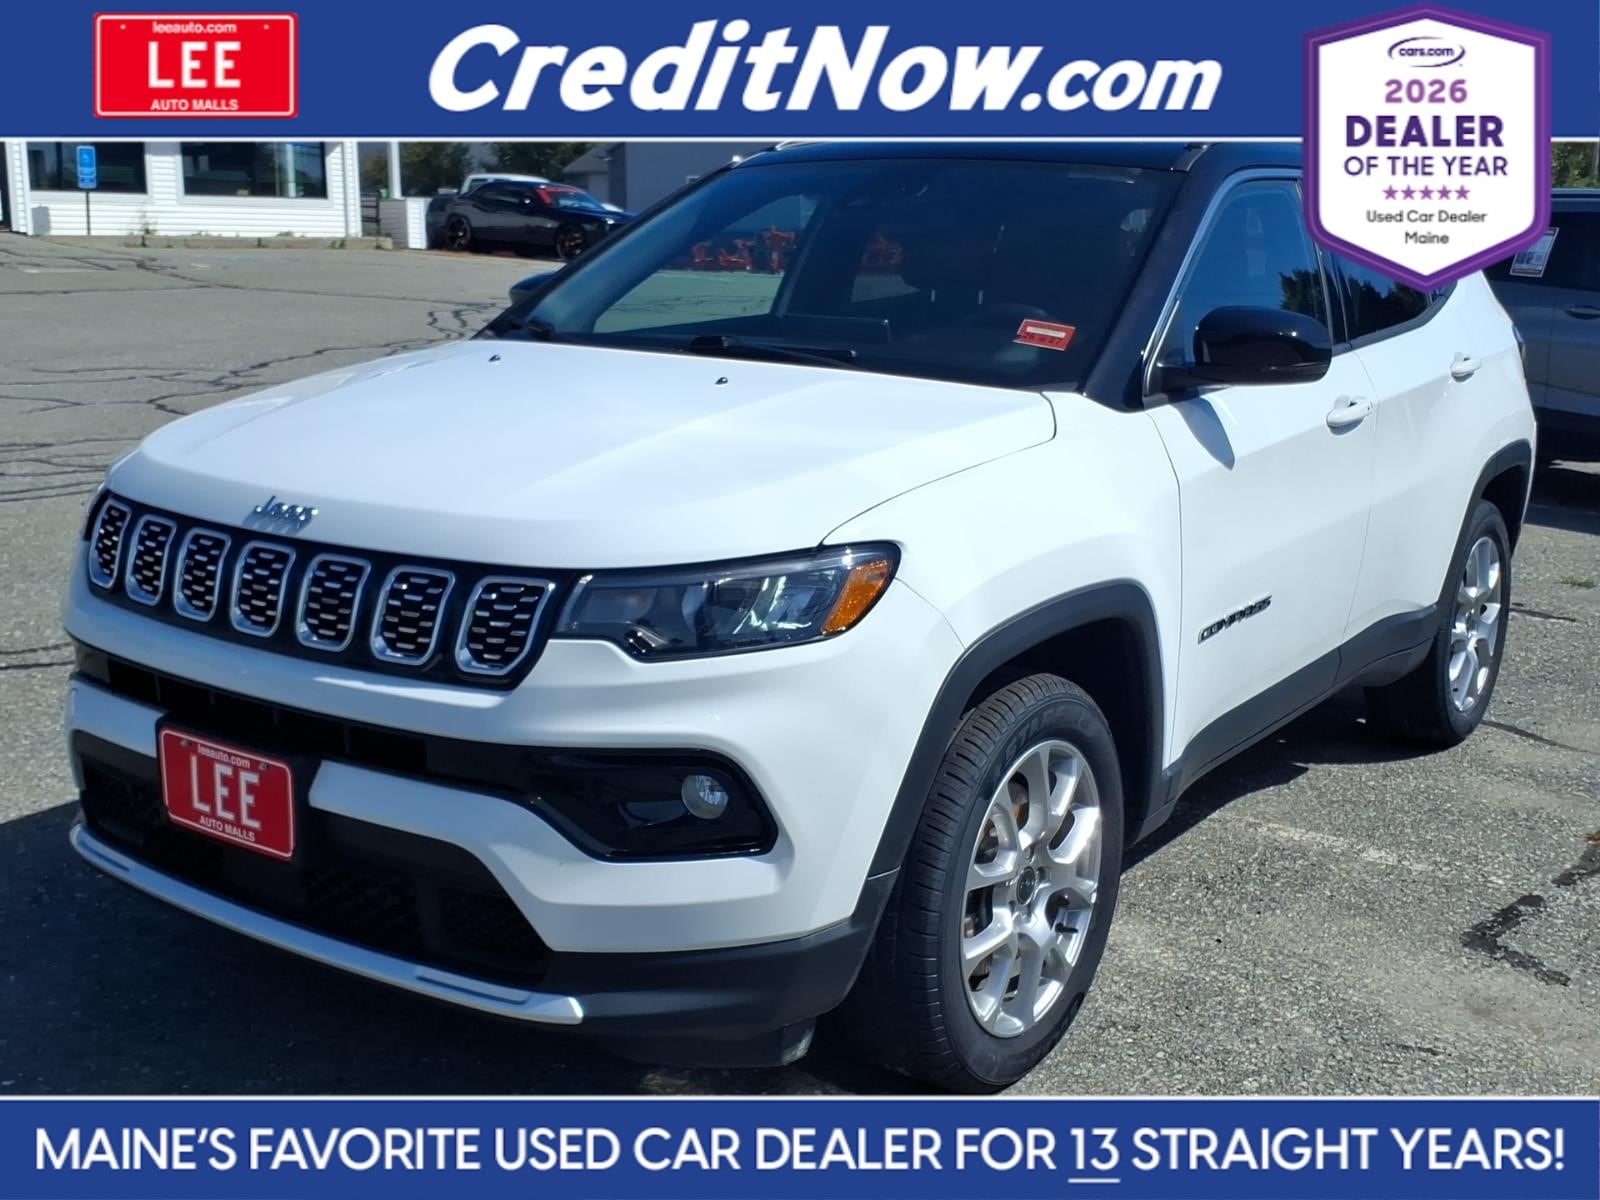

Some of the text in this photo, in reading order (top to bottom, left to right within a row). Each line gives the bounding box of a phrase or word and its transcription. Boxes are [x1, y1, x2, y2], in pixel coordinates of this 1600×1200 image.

[197, 744, 251, 769] leeauto.com
[190, 754, 262, 830] LEE
[199, 815, 256, 842] AUTO MALLS
